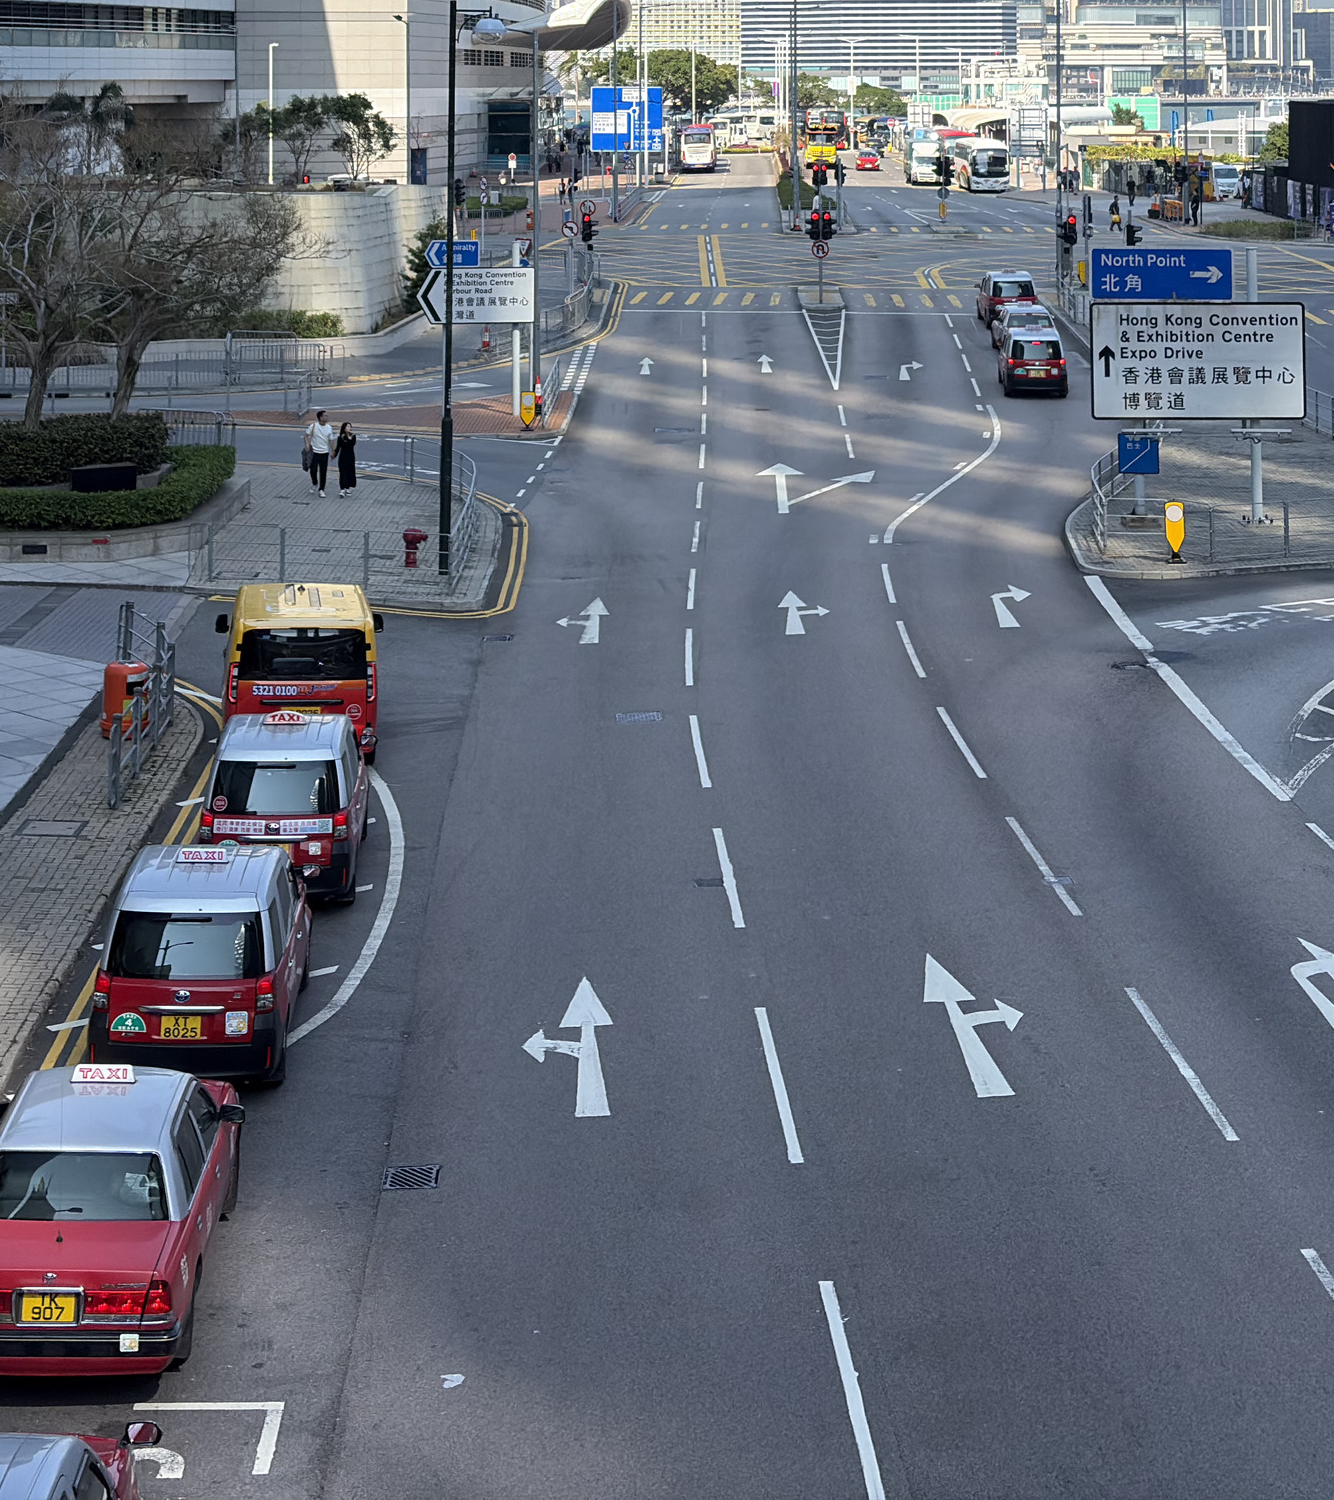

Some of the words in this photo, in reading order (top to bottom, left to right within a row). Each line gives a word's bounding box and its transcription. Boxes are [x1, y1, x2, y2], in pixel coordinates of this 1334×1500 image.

[442, 244, 476, 252] Amiralty
[1101, 254, 1143, 266] North
[1147, 254, 1186, 266] Point
[1101, 274, 1142, 292] 北角
[1120, 313, 1158, 329] Hong
[1165, 313, 1202, 329] Kong
[1211, 313, 1298, 326] Convention
[1120, 332, 1130, 343] &
[1137, 331, 1214, 343] Exhibition
[1222, 331, 1274, 343] Centre
[1120, 347, 1158, 363] Expo
[1164, 347, 1203, 360] Drive
[1122, 366, 1296, 386] 香港會議展覽中心
[1122, 392, 1186, 411] 博覽道
[252, 685, 273, 696] 5321
[275, 685, 297, 696] 0100
[270, 712, 300, 722] TAXI
[182, 851, 224, 860] TAXI
[173, 1017, 189, 1027] XT
[163, 1028, 198, 1038] 8025
[79, 1068, 128, 1079] TAXI
[39, 1294, 58, 1307] TK
[31, 1307, 65, 1320] 907
